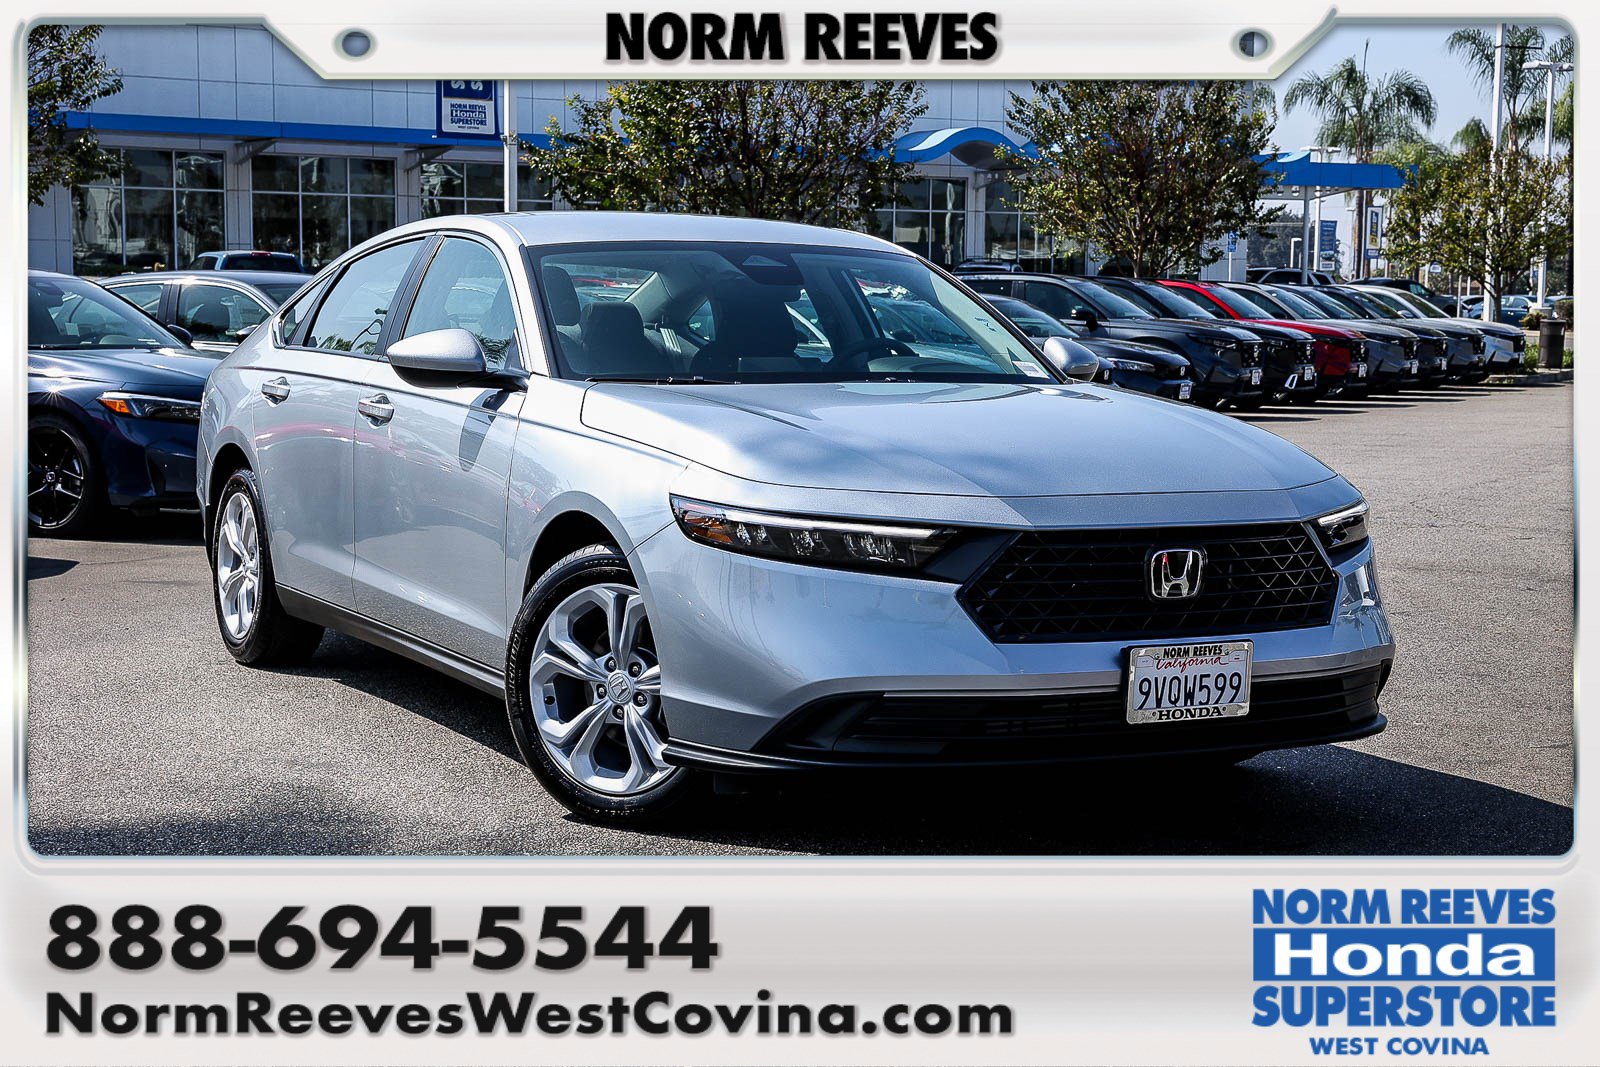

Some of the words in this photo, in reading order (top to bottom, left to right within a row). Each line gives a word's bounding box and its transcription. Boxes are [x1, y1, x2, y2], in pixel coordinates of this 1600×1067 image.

[452, 110, 485, 118] Honda
[450, 118, 487, 126] SUPERSTORE
[1163, 647, 1190, 659] NORM
[1193, 645, 1223, 657] REEVES
[1156, 656, 1229, 673] California
[1137, 672, 1242, 710] 9VQW599
[1156, 706, 1224, 720] HONDA
